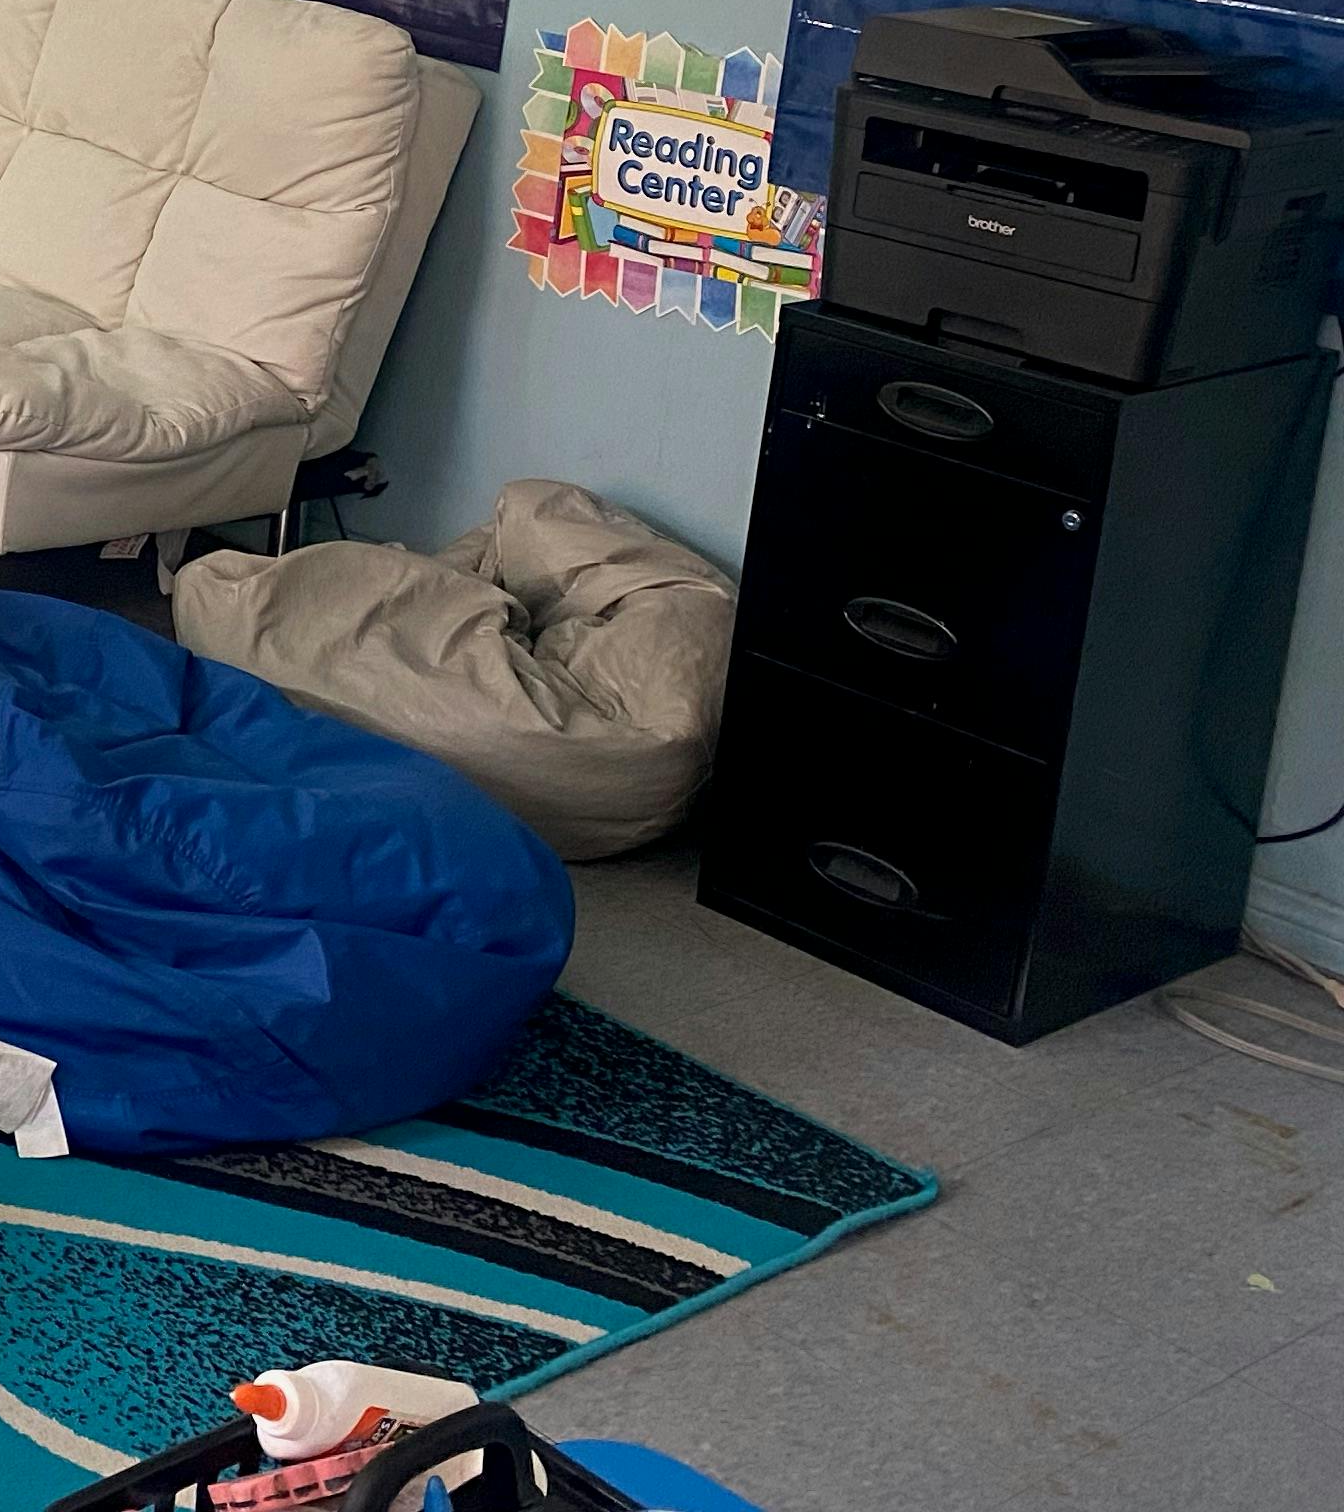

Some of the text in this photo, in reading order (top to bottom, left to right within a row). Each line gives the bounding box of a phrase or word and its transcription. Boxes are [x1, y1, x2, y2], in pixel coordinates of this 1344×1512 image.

[608, 118, 763, 190] Reading
[617, 159, 744, 216] Center
[967, 214, 1017, 237] brother
